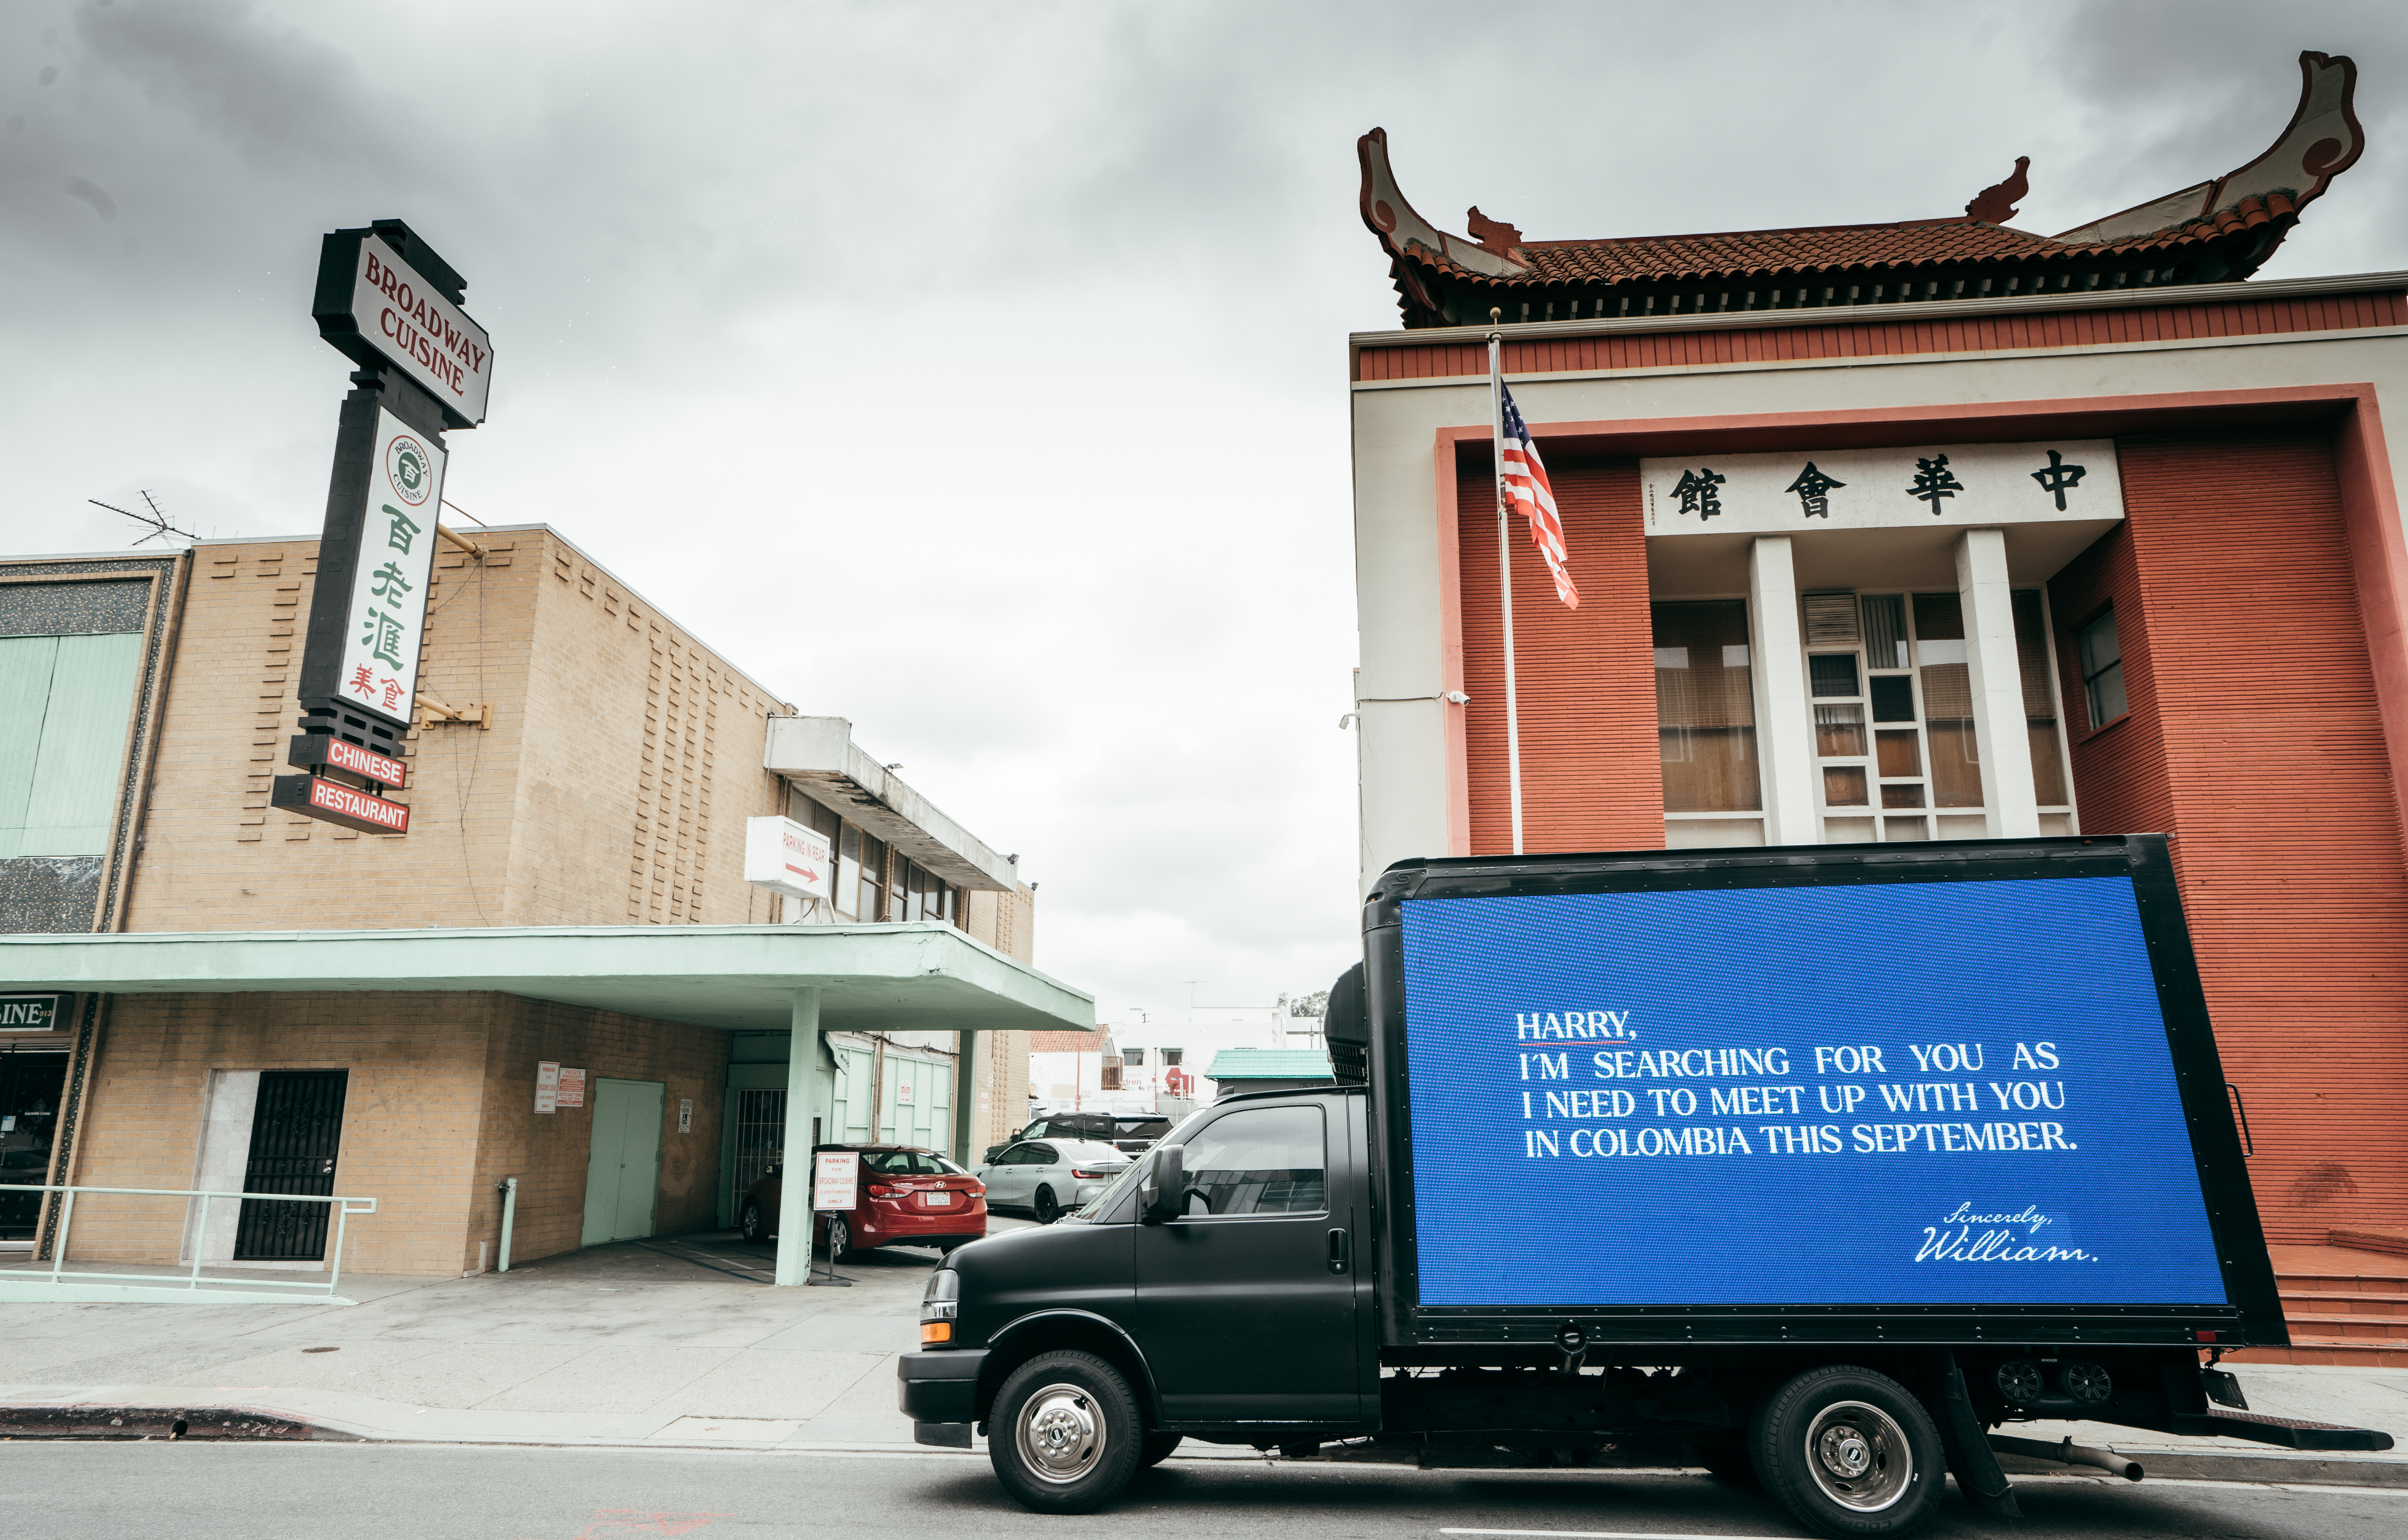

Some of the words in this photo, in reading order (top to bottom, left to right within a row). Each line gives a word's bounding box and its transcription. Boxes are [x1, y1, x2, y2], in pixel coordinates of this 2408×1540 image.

[365, 252, 485, 374] BROADWAY
[380, 307, 464, 397] CUISINE
[395, 441, 428, 477] BROADWAY
[393, 474, 423, 500] CUISINE
[350, 663, 405, 711] 美食
[331, 743, 401, 783] CHINESE
[315, 784, 405, 827] RESTAURANT
[783, 832, 805, 856] PARKING
[806, 842, 811, 858] IN
[812, 845, 825, 864] REAR
[0, 1003, 42, 1024] INE
[1517, 1010, 1637, 1041] HARRY,
[1519, 1052, 1568, 1080] I'M
[1593, 1048, 1790, 1078] SEARCHING
[1814, 1046, 1887, 1073] FOR
[1909, 1044, 1983, 1071] YOU
[2012, 1042, 2059, 1070] AS
[1522, 1092, 1532, 1119] I
[1546, 1090, 1635, 1118] NEED
[1647, 1088, 1697, 1116] TO
[1711, 1086, 1805, 1115] MEET
[1818, 1085, 1865, 1113] UP
[1878, 1083, 1978, 1112] WITH
[1989, 1082, 2065, 1110] YOU
[1525, 1130, 1559, 1158] IN
[1570, 1127, 1753, 1157] COLOMBIA
[1759, 1125, 1843, 1153] THIS
[1852, 1122, 2078, 1153] SEPTEMBER.
[1943, 1201, 2052, 1234] Sincerely,
[1915, 1225, 2098, 1262] William.
